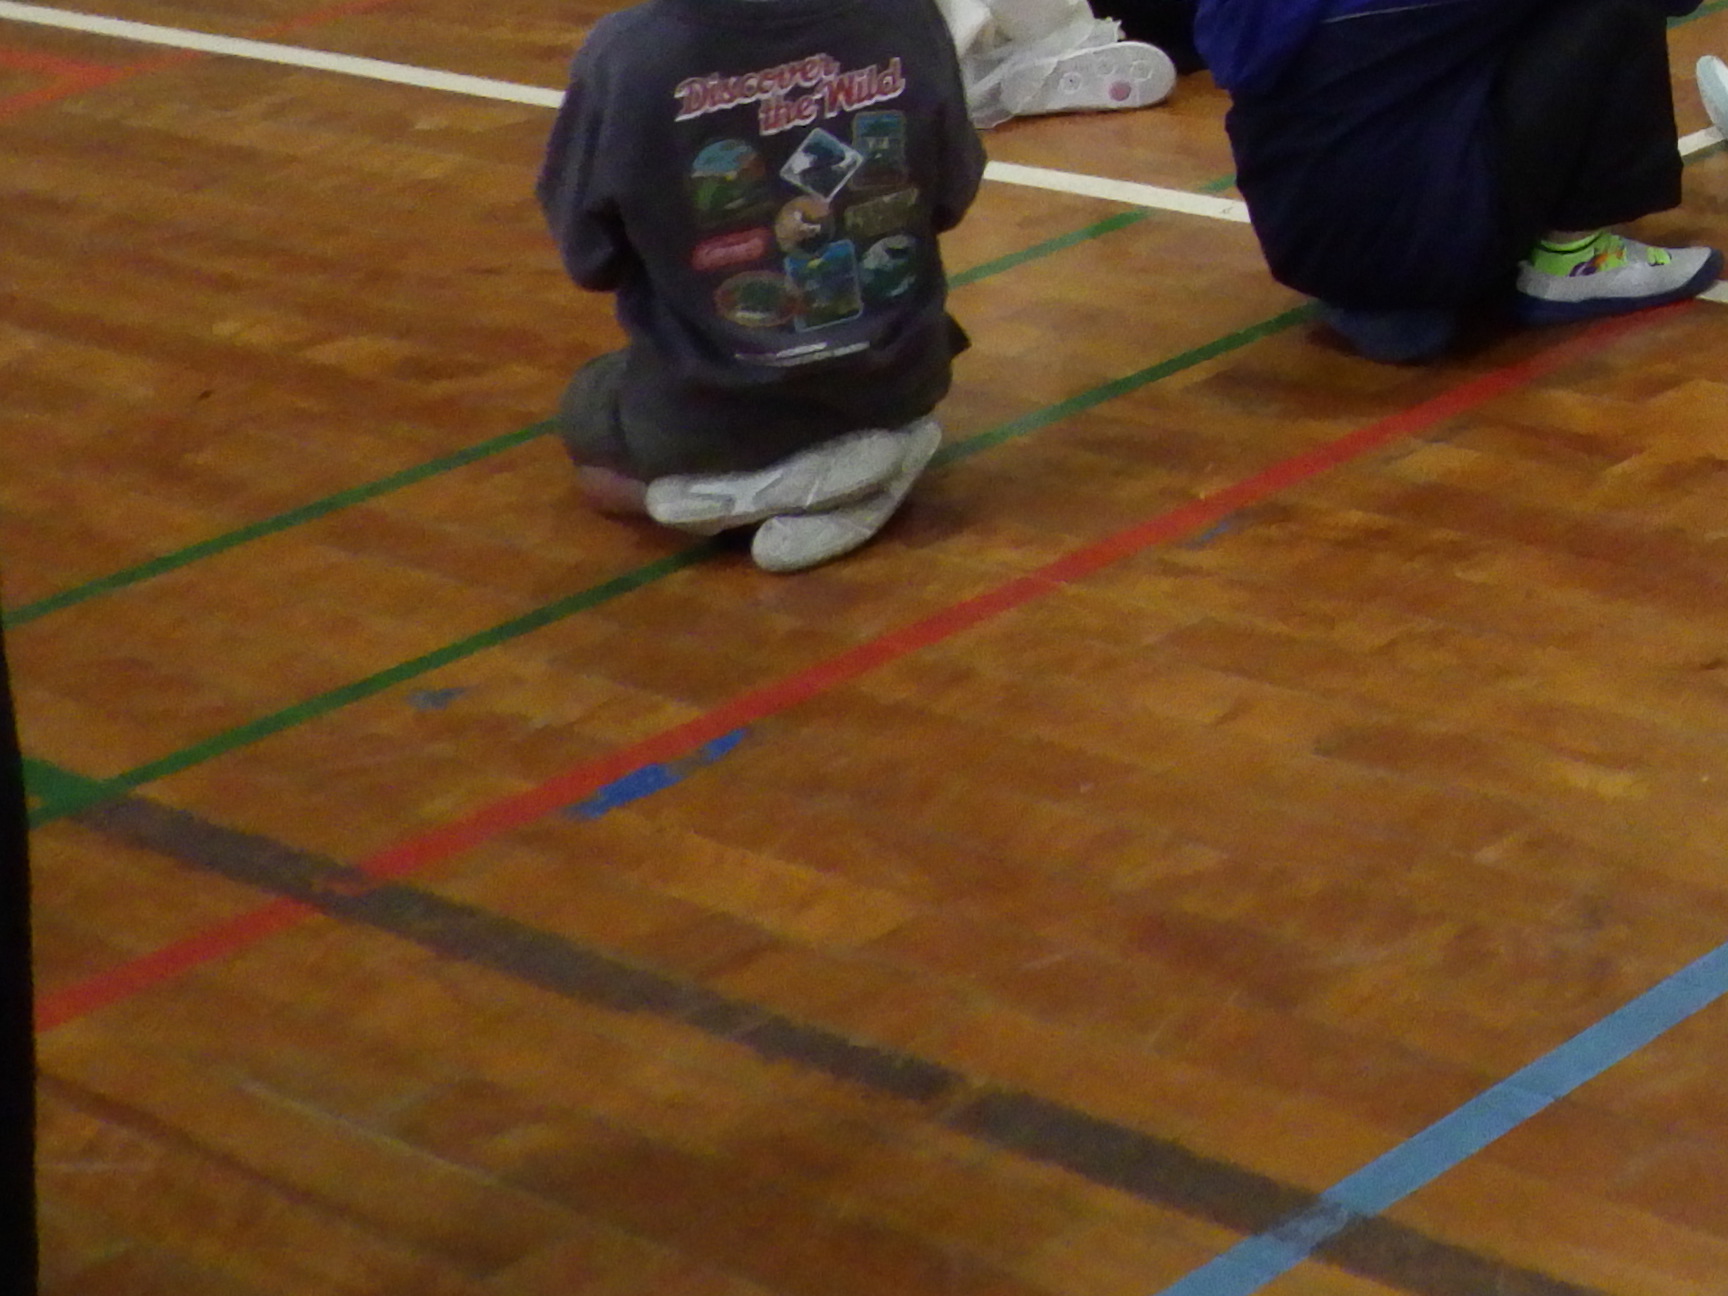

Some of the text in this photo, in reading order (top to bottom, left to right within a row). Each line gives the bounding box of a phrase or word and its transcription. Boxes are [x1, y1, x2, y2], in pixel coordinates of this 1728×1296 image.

[674, 51, 841, 122] Discover
[758, 56, 906, 136] the Wild
